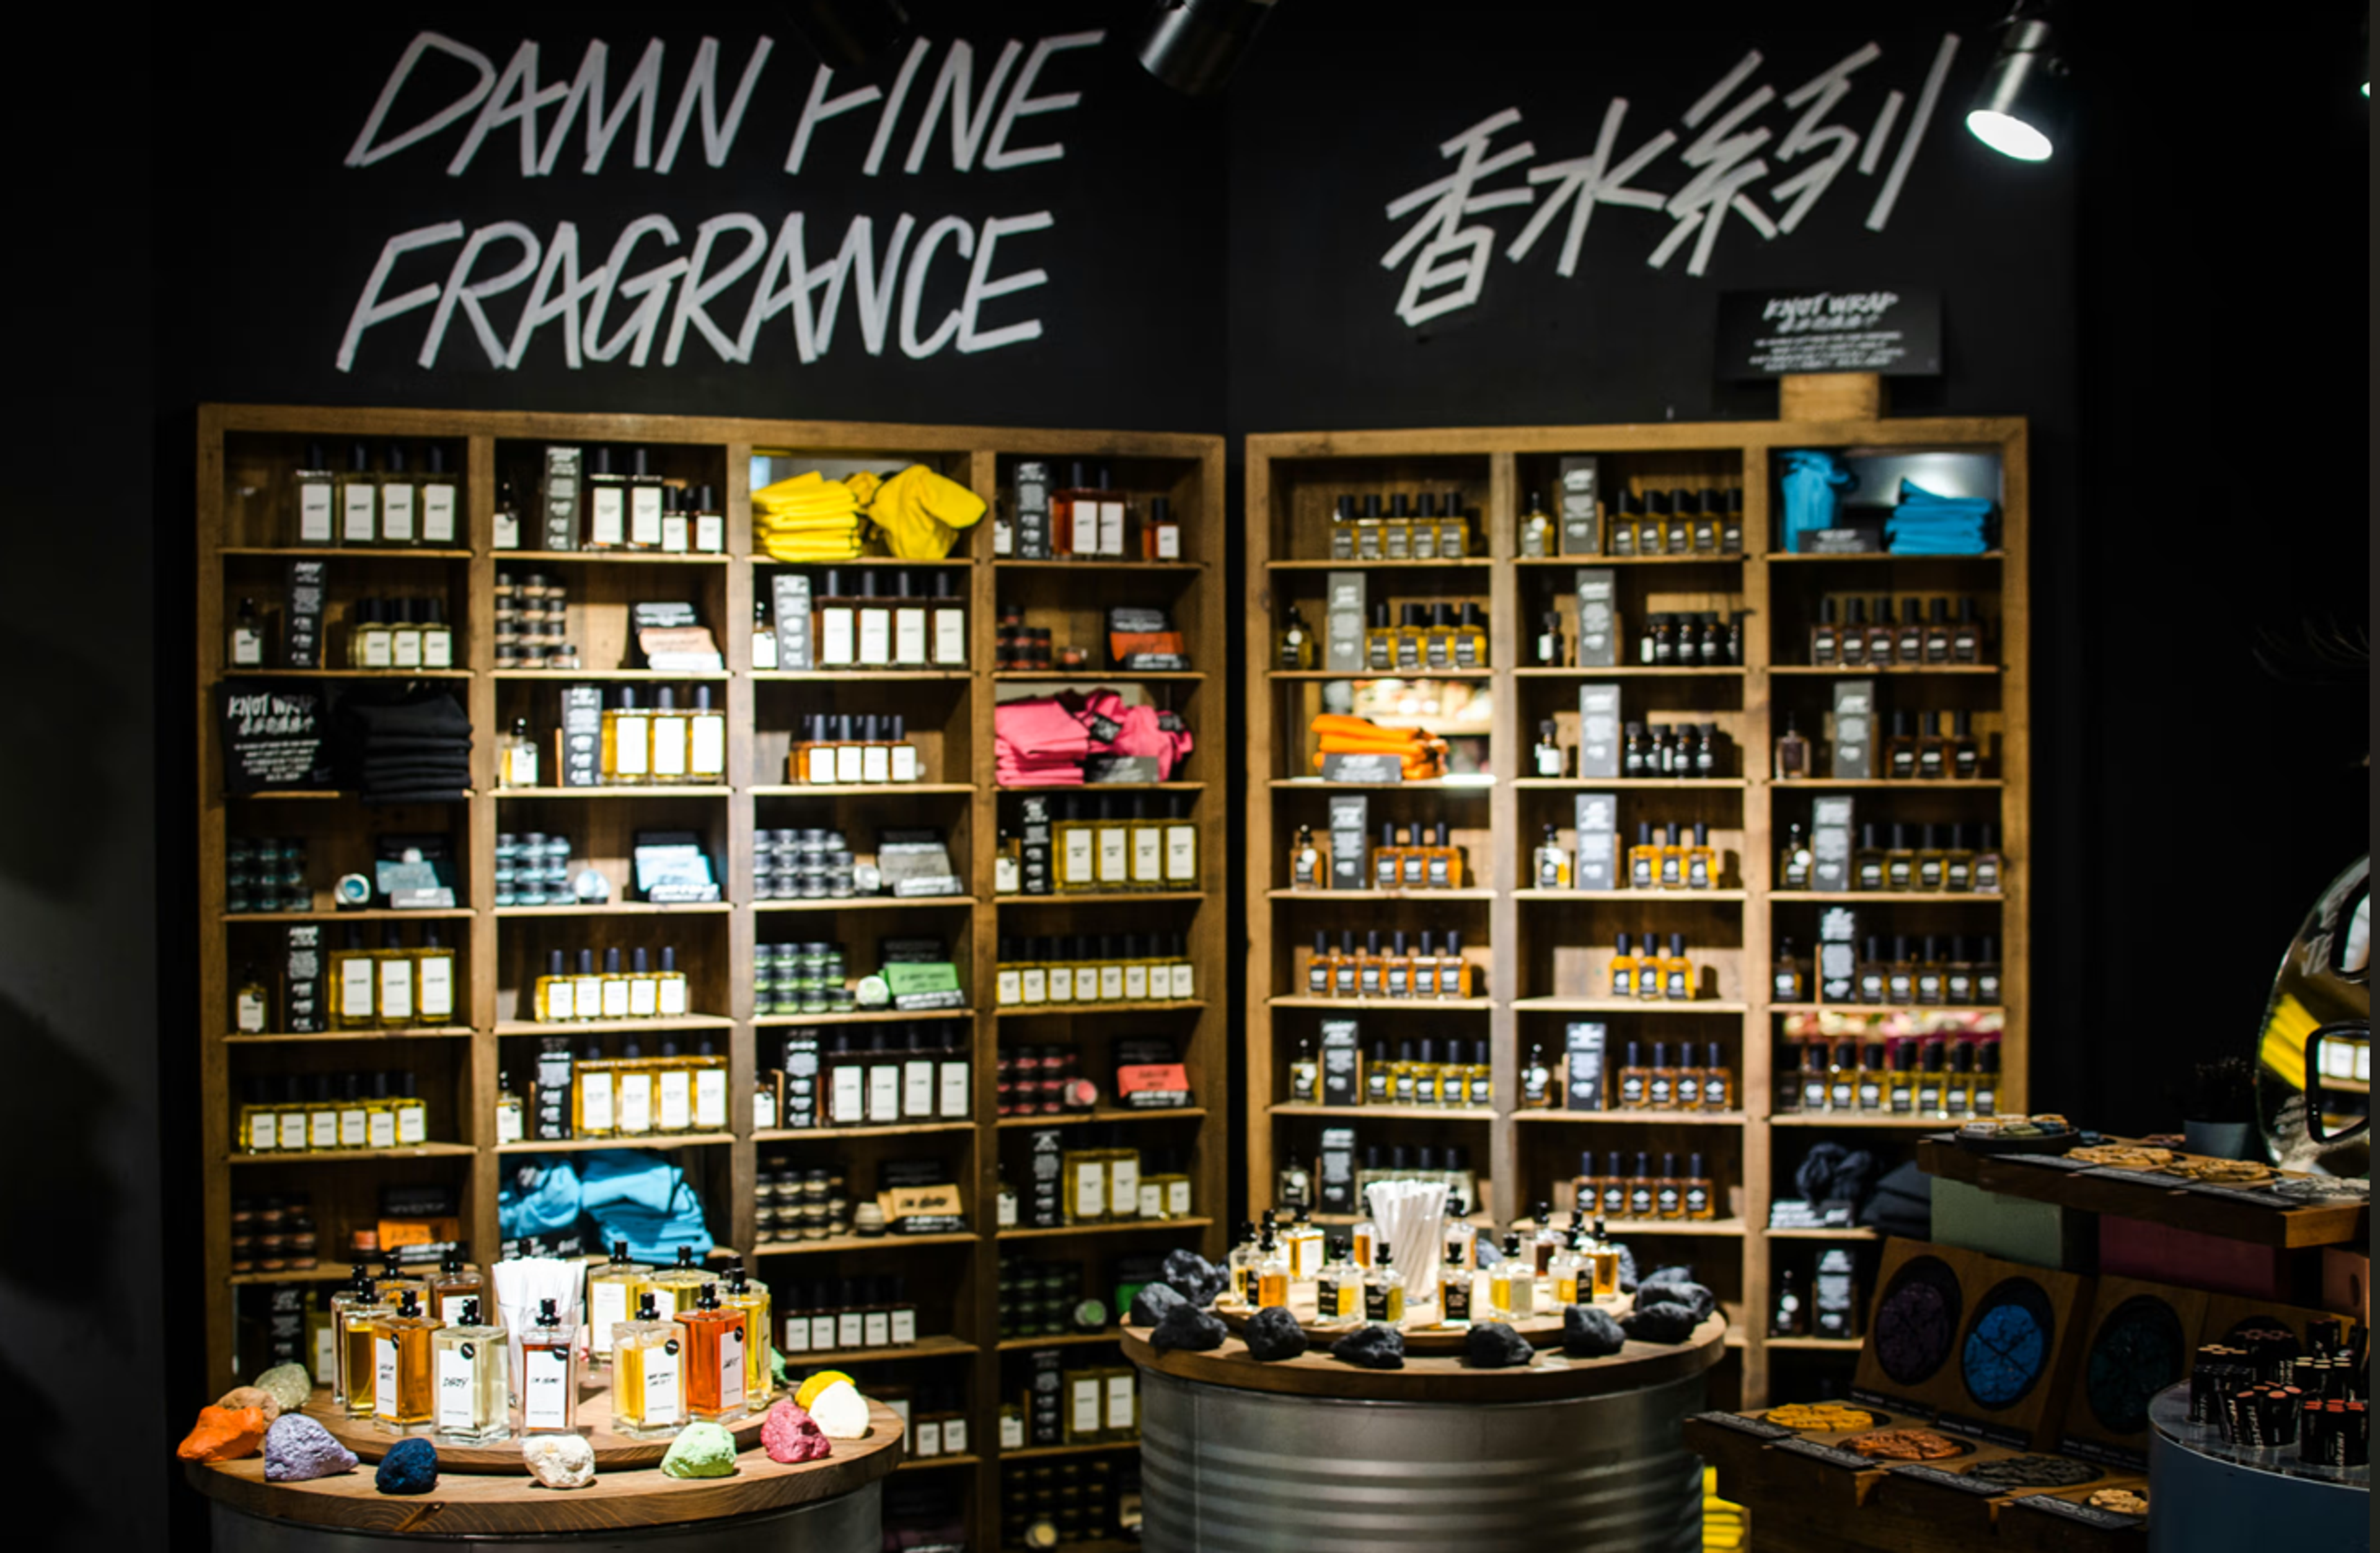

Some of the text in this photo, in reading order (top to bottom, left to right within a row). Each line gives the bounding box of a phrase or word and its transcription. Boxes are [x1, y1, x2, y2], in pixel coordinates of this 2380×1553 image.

[343, 31, 774, 177] DAMN
[1380, 32, 1960, 327] 香水系列
[335, 209, 1054, 373] FRAGRANCE
[227, 692, 270, 719] KNOT
[443, 1376, 470, 1388] DIRTY
